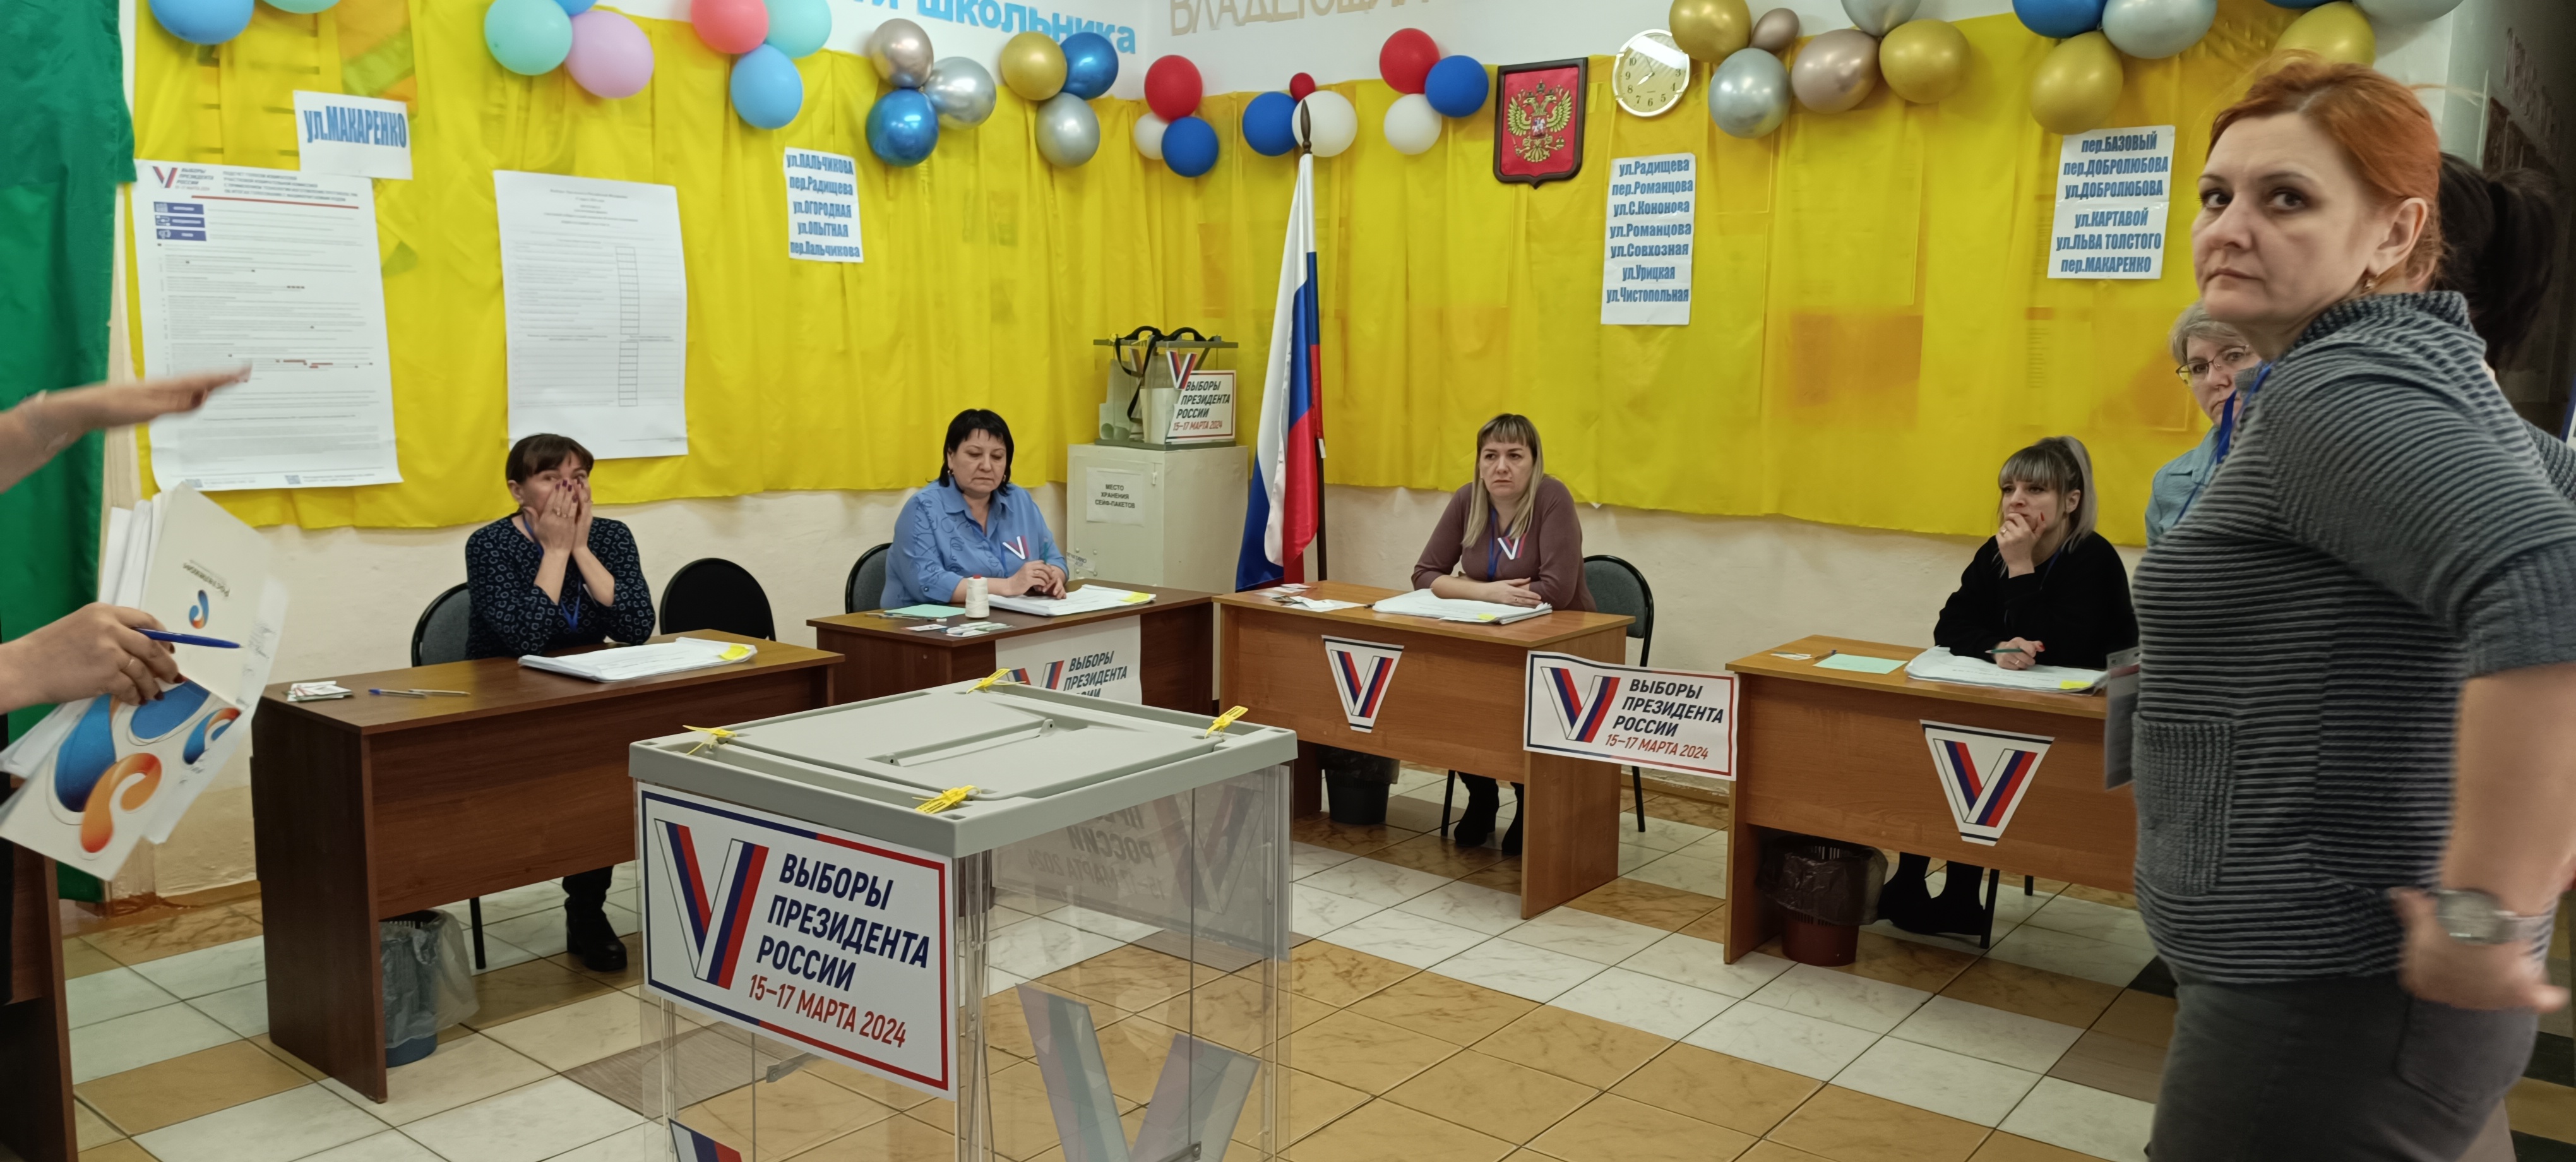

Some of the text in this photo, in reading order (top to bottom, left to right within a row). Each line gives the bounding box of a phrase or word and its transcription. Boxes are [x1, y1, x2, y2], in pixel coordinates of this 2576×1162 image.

[1625, 71, 1631, 80] 9
[1627, 85, 1633, 93] 8
[1661, 93, 1666, 102] 5
[1636, 95, 1641, 104] 7
[1647, 98, 1653, 107] 6
[304, 105, 407, 148] ул.МАКАРЕНКО
[2081, 130, 2157, 153] пер.БАЗОВЫЙ
[786, 153, 854, 175] ул.ПАЛЬЧИКОВА
[1619, 159, 1690, 177] ул.Радищева
[2063, 156, 2168, 177] пер.ДОБРОЛЮБОВА
[789, 176, 854, 196] пер.Радищева
[1612, 179, 1693, 196] пер.Романцова
[2065, 179, 2163, 200] ул.ДОБРОЛЮБОВА
[793, 200, 852, 219] ул.ОГОРОДНАЯ
[1613, 201, 1690, 217] ул.С.Кононова
[2075, 207, 2149, 229] ул.КАРТАВОЙ
[797, 221, 849, 237] ул.ОПЫТНАЯ
[1609, 223, 1691, 239] ул.Романцова
[790, 241, 860, 258] пер.Пальчикова
[1611, 243, 1689, 258] ул.Совхозная
[2056, 232, 2162, 251] ул.ЛЬВА ТОЛСТОГО
[1622, 265, 1675, 282] ул.Урицкая
[2061, 256, 2152, 273] пер.МАКАРЕНКО
[1606, 287, 1689, 304] ул.Чистопольная
[1185, 381, 1221, 391] ВЫБОРЫ
[1181, 394, 1231, 405] ПРЕЗИДЕНТА
[1176, 408, 1210, 419] РОССИИ
[1190, 421, 1209, 429] МАРТА
[1209, 420, 1223, 429] 2024
[1068, 650, 1114, 672] ВЫБОРЫ
[1063, 666, 1128, 691] ПРЕЗИДЕНТА
[1629, 678, 1703, 700] ВЫБОРЫ
[1621, 696, 1724, 724] ПРЕЗИДЕНТА
[1612, 715, 1679, 737] РОССИИ
[1638, 740, 1677, 757] МАРТА
[1679, 745, 1708, 760] 2024
[779, 853, 894, 911] ВЫБОРЫ
[767, 894, 930, 969] ПРЕЗИДЕНТА
[756, 935, 857, 991] РОССИИ
[796, 990, 857, 1033] МАРТА
[859, 1011, 906, 1048] 2024
